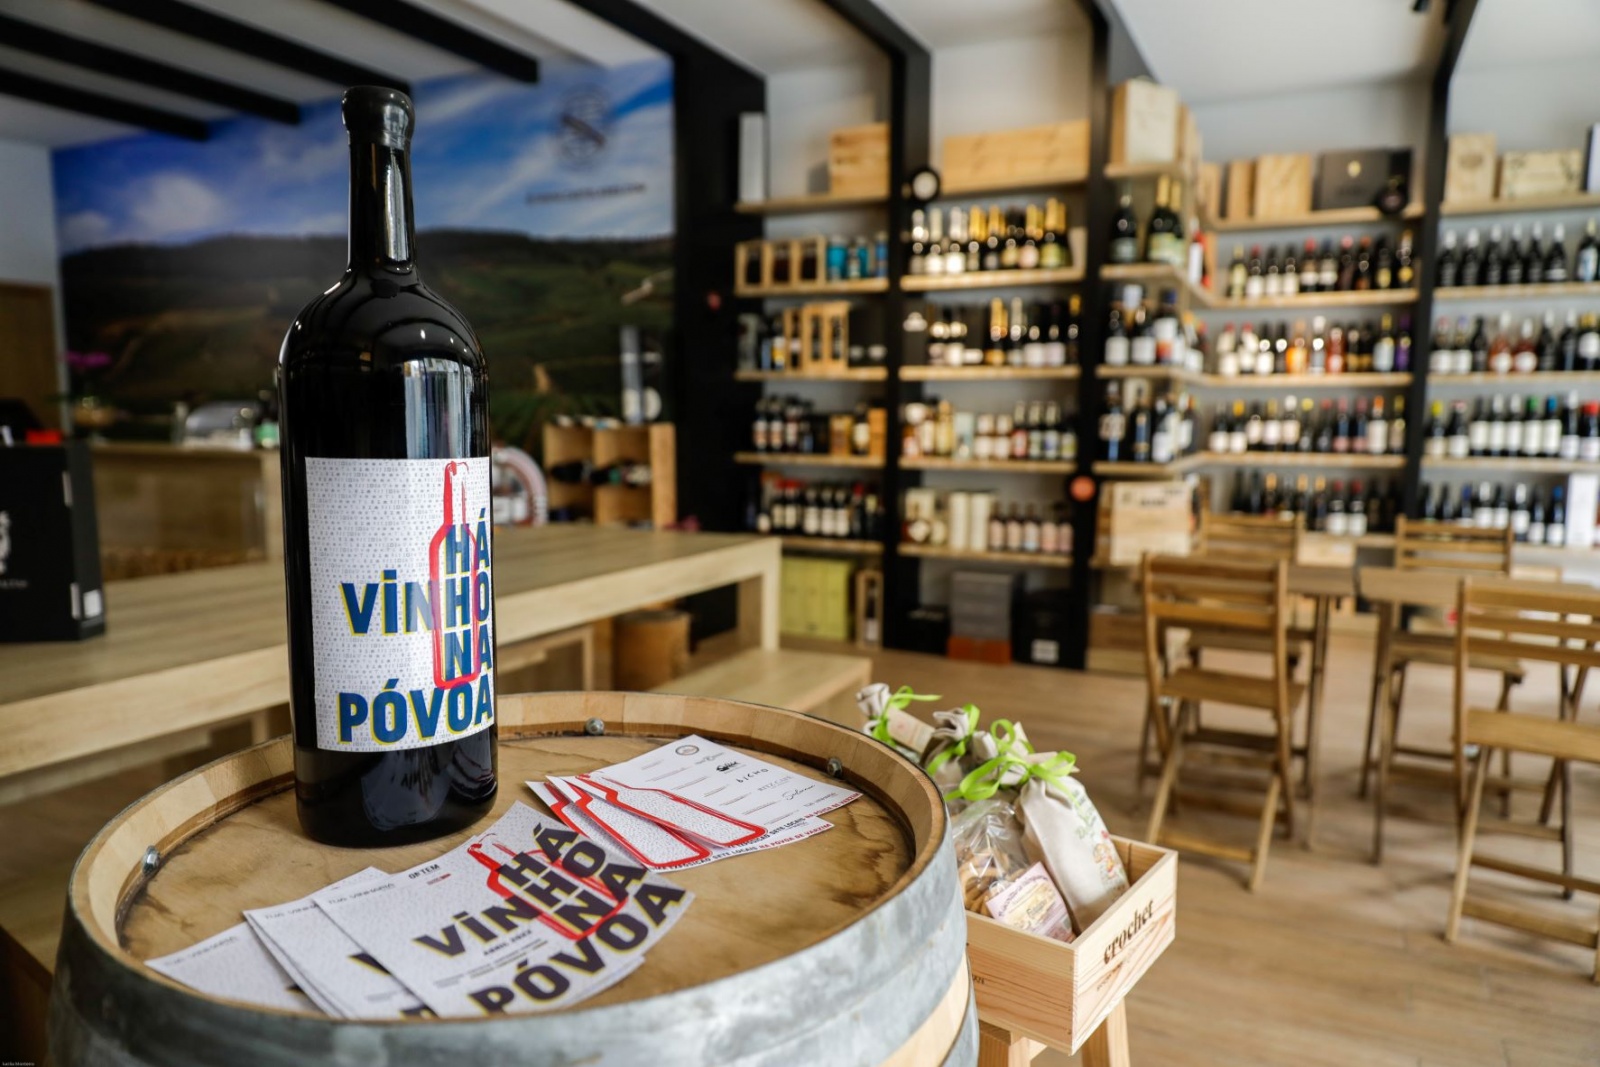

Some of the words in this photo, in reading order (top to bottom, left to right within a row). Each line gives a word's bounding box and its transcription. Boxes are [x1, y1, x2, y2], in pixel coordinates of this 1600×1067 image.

[445, 507, 490, 575] HÁ
[442, 624, 492, 682] NA
[338, 673, 493, 745] PÓVOA
[498, 823, 580, 889] HÁ
[552, 863, 648, 935] NA
[1104, 900, 1153, 964] crochet
[467, 883, 687, 1014] PÓVOA
